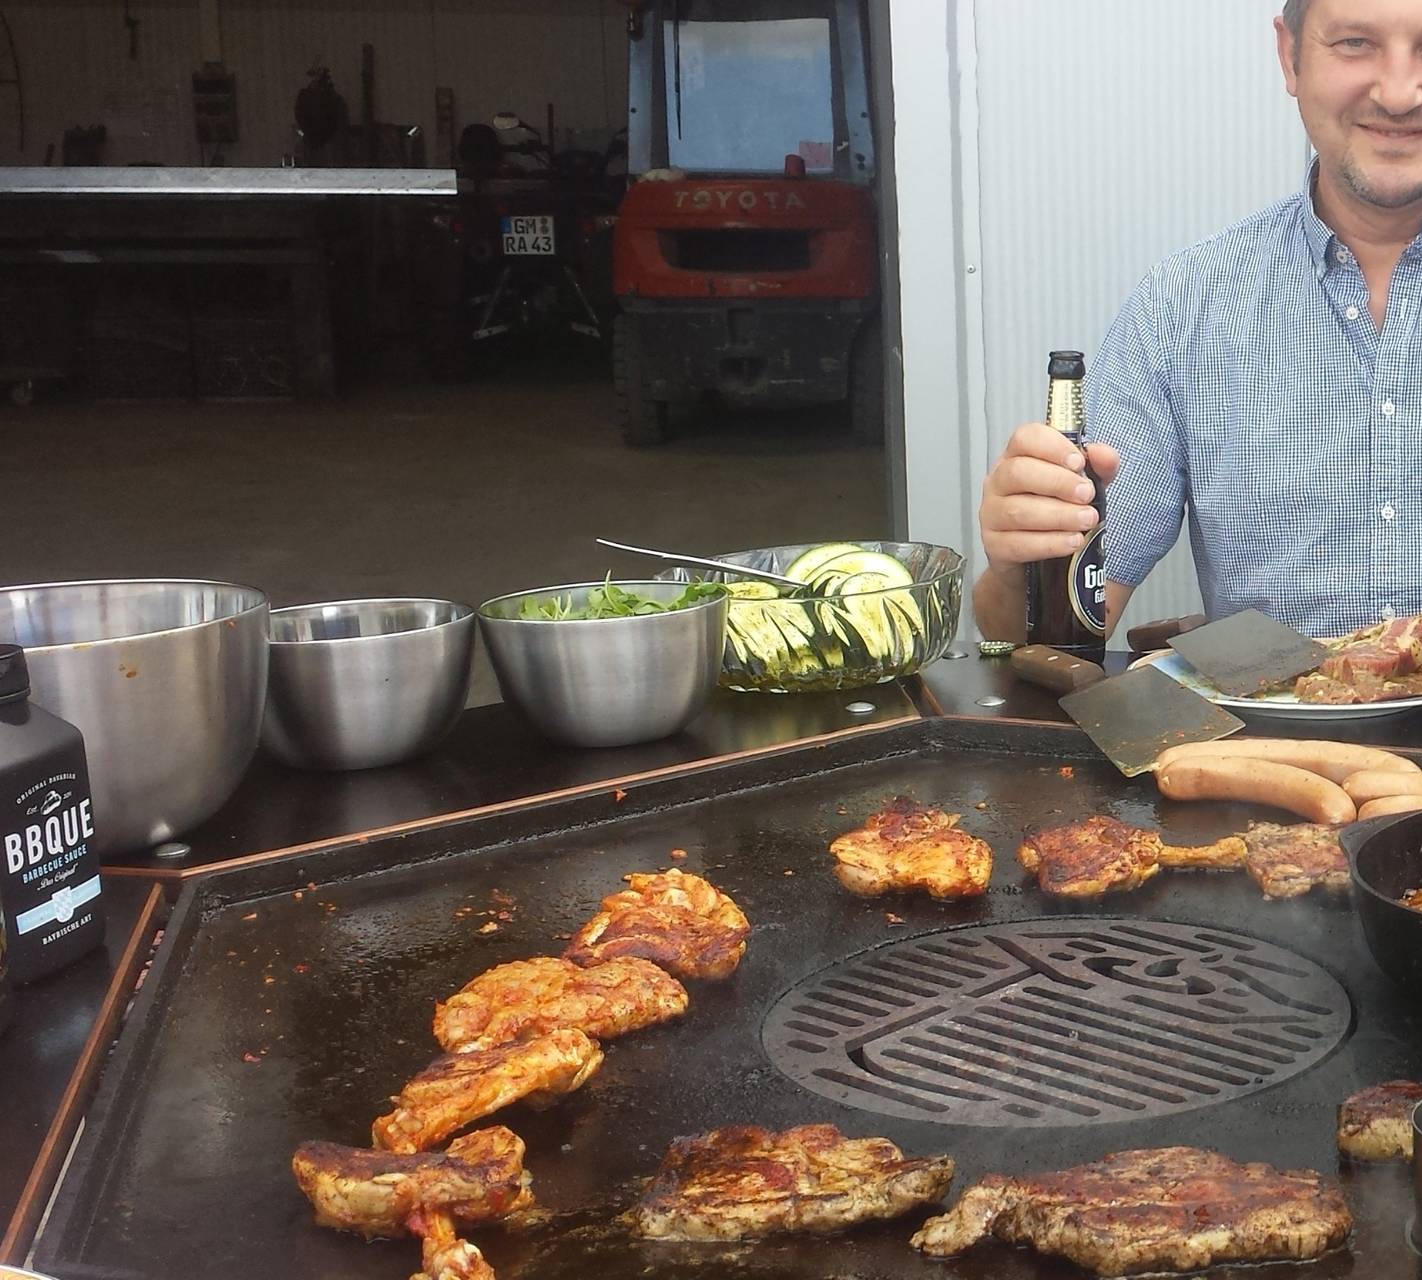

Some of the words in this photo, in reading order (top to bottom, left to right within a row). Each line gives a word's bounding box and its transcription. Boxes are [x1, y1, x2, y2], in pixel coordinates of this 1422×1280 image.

[675, 190, 806, 210] TOYOTA
[514, 218, 537, 234] GM
[506, 236, 528, 252] RA
[532, 236, 552, 252] 43
[16, 780, 47, 804] ORIGINAL
[48, 772, 77, 784] BAVARIAN
[4, 798, 94, 874] BBQUE
[22, 856, 63, 884] BARBECUE
[63, 844, 87, 864] SAUCE
[42, 921, 80, 945] BAYRISCHE
[80, 913, 92, 927] ART
